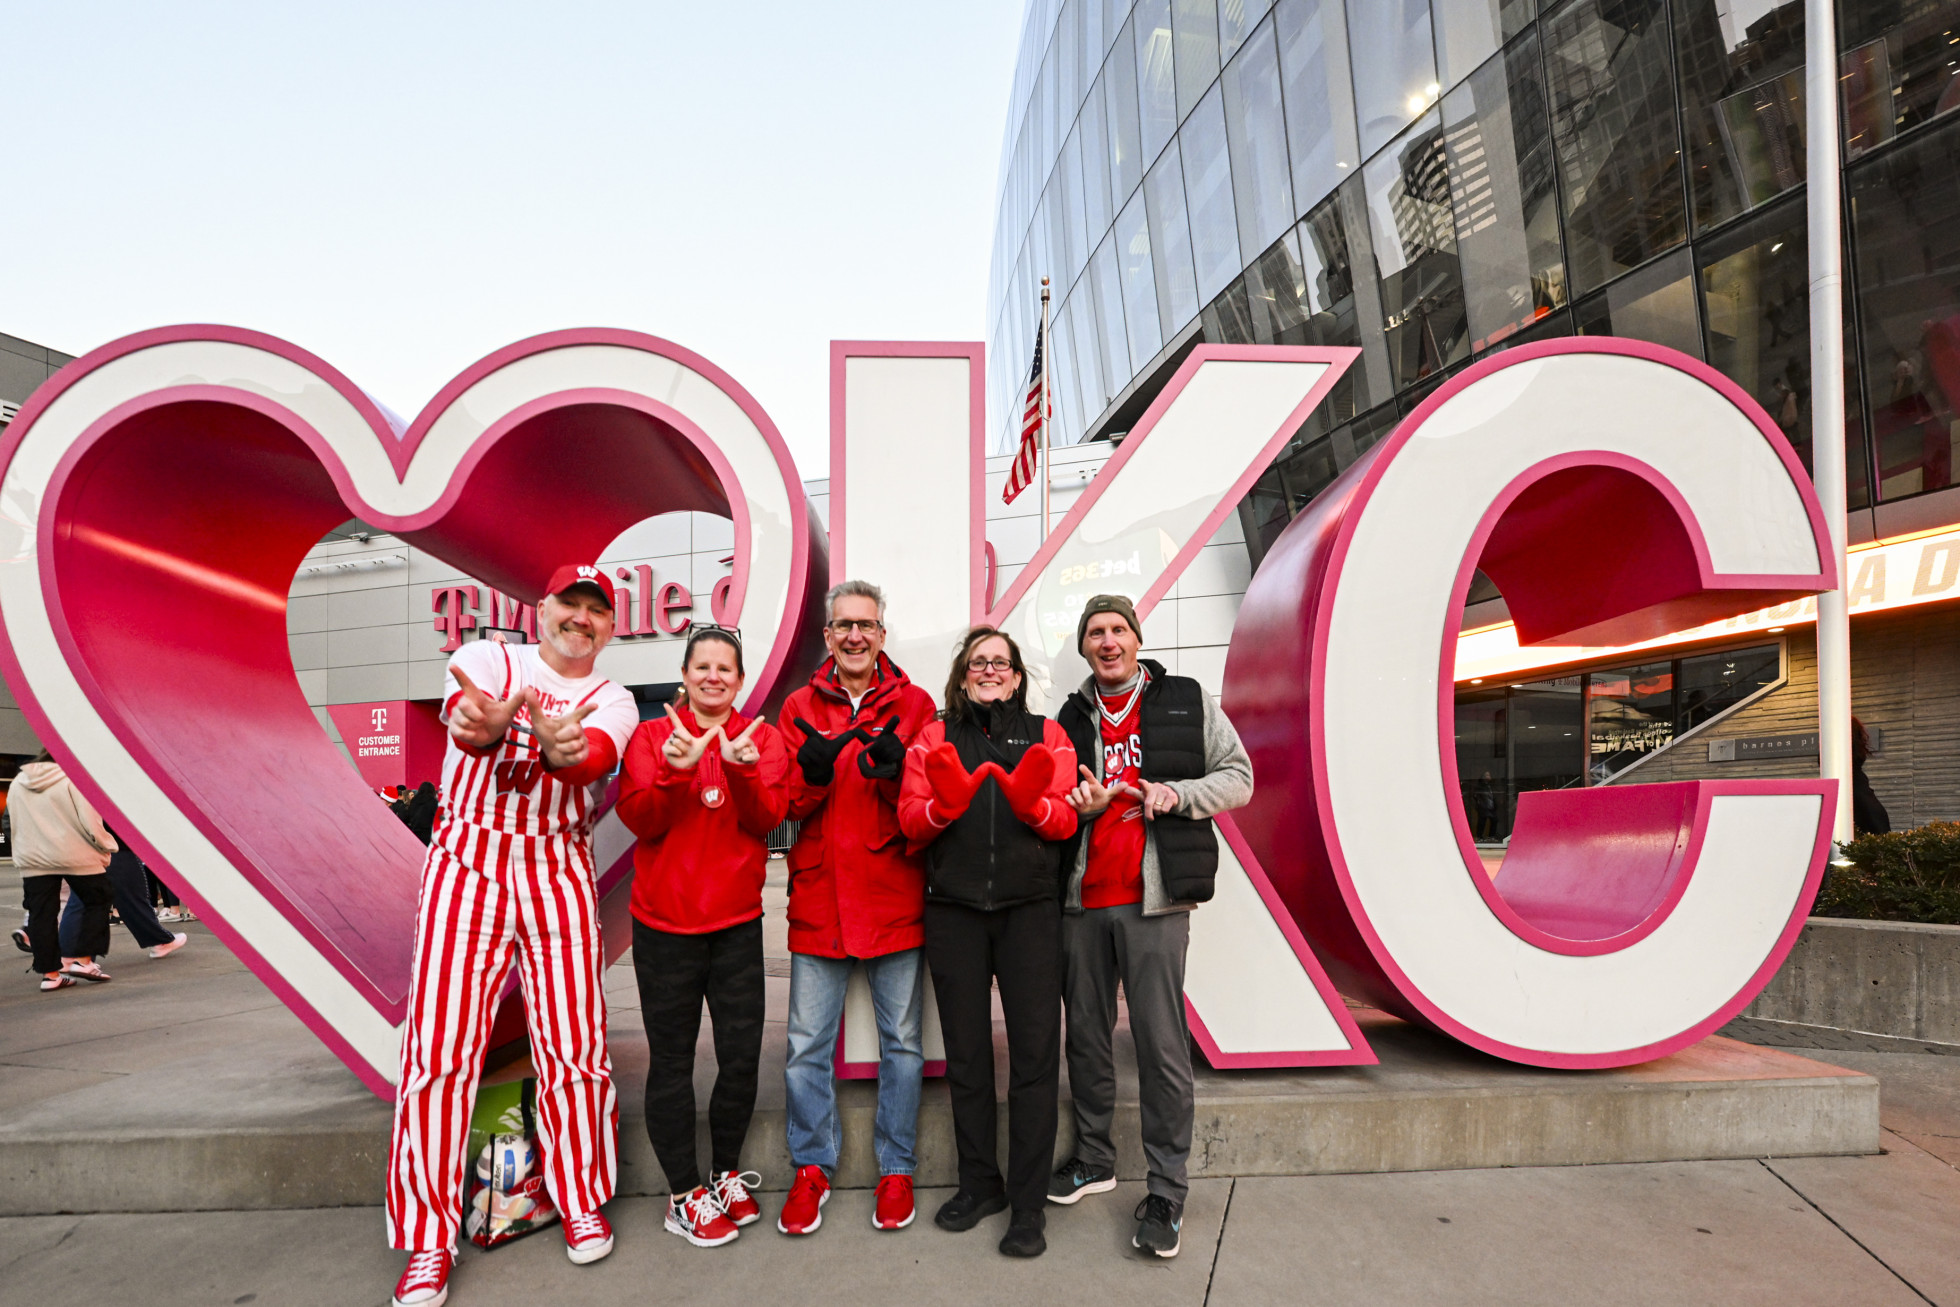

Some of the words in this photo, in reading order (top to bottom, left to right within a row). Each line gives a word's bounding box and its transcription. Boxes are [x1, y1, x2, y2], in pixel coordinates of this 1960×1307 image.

[577, 565, 599, 579] W
[484, 564, 693, 644] Mile
[358, 735, 400, 746] CUSTOMER
[1742, 740, 1791, 750] barnes
[358, 746, 400, 757] ENTRANCE
